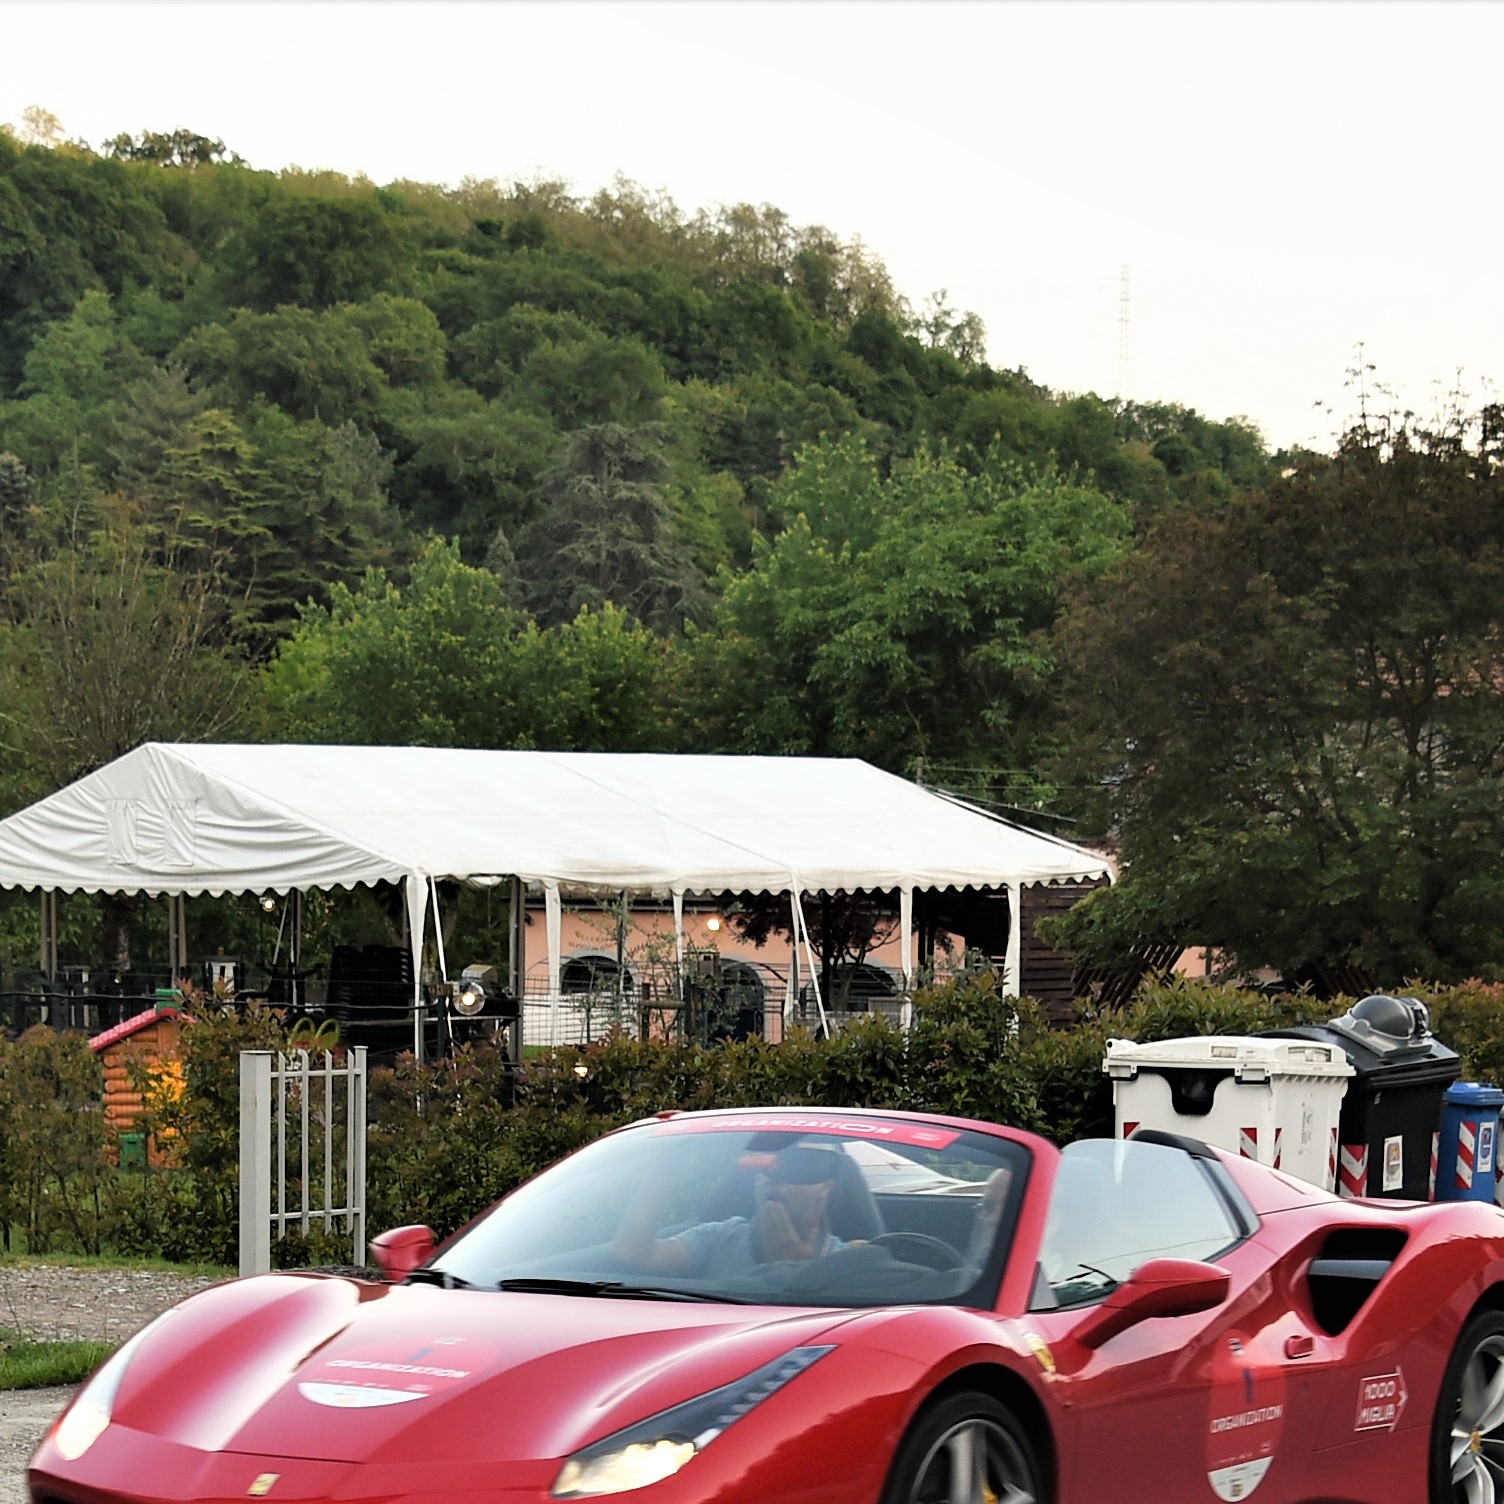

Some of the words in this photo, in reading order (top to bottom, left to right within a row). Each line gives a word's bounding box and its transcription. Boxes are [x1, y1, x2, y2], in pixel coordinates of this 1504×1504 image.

[712, 1120, 894, 1134] ORGANIZATION
[326, 1359, 472, 1379] ORGANIZATION
[1364, 1380, 1395, 1400] 1000
[1210, 1404, 1283, 1433] ORGANIZATION
